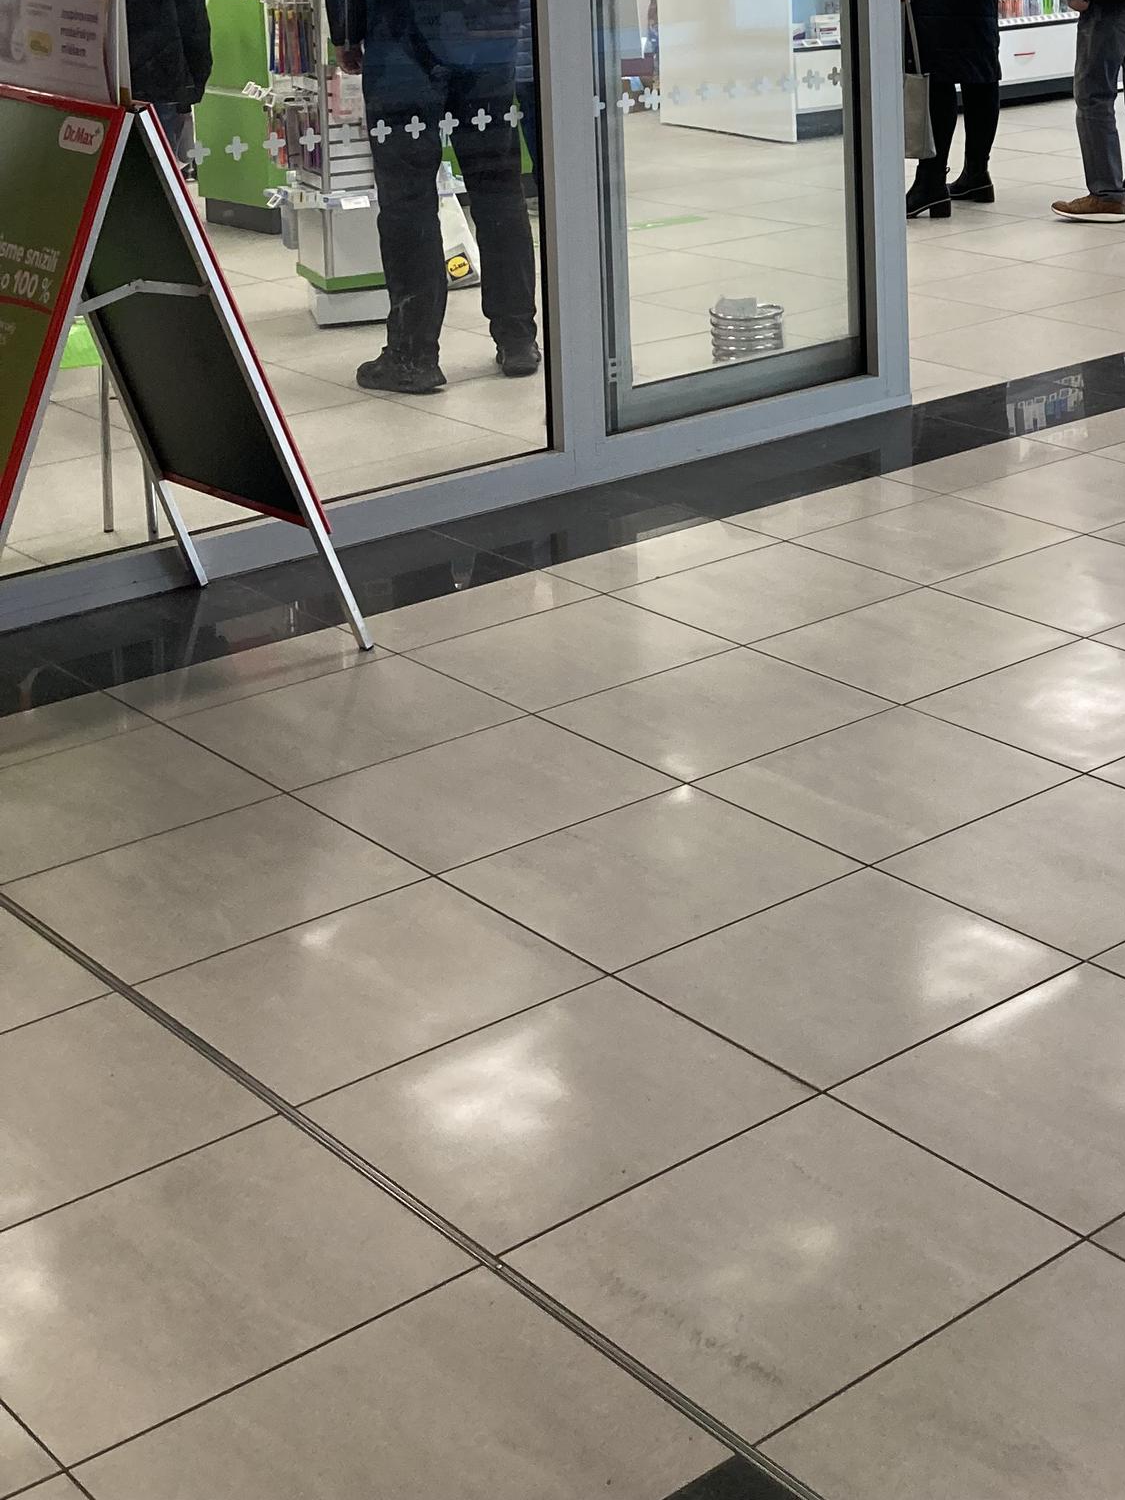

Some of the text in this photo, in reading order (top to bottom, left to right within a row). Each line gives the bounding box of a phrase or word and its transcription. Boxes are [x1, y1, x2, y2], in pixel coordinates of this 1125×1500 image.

[0, 241, 24, 263] sme
[13, 269, 39, 299] 100
[40, 277, 52, 304] %
